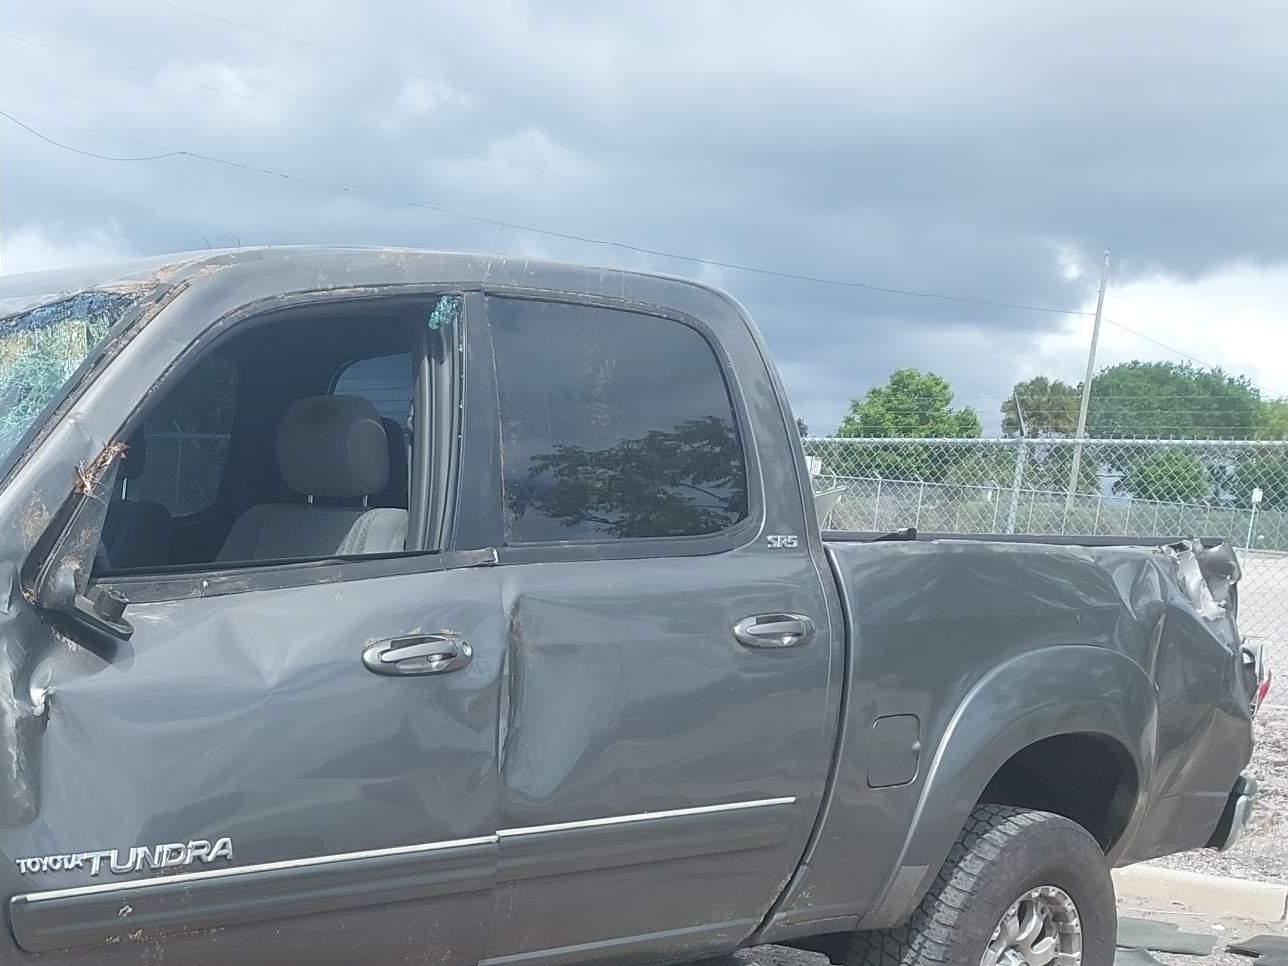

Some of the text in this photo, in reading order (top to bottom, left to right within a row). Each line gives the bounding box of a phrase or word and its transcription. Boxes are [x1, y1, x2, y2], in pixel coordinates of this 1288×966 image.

[767, 535, 799, 549] SR5
[15, 837, 234, 877] TOYOTA TUNDRA
